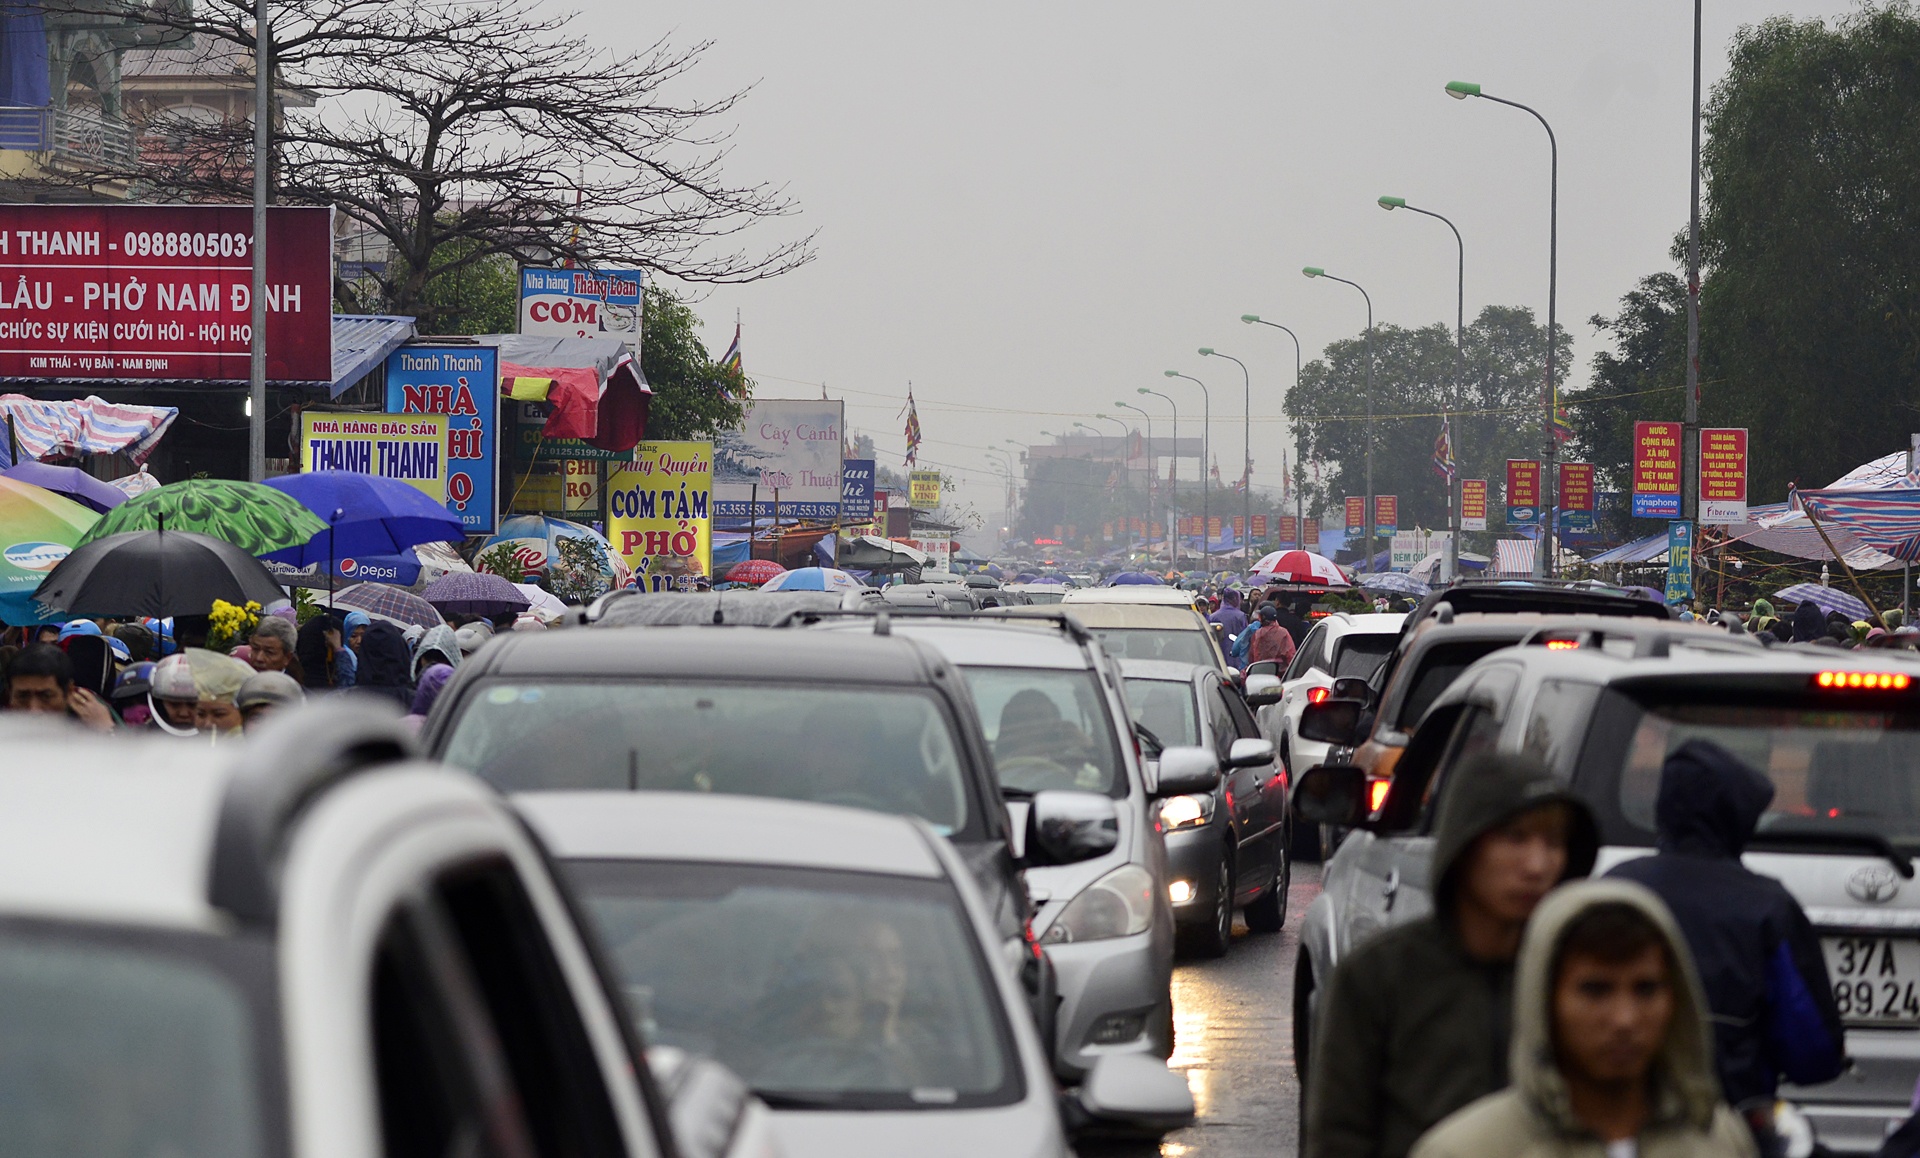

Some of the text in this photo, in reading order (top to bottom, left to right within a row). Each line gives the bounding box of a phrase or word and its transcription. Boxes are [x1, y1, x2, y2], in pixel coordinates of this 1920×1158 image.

[17, 231, 100, 256] THANH
[0, 275, 52, 310] LẨU
[84, 276, 147, 310] PHỞ
[157, 283, 220, 312] NAM
[230, 284, 301, 312] ĐNH
[525, 273, 546, 289] Nhà
[546, 274, 569, 293] hàng
[609, 274, 637, 296] Loan
[530, 298, 597, 324] CƠM
[0, 318, 252, 345] CHỨC SỰ KIỆN CƯỚI HỎI HỘI HỌ
[30, 355, 168, 372] KIM THÁI VỤ BẢN NAM ĐỊNH
[401, 354, 482, 372] Thanh Thanh
[402, 377, 478, 416] NHÀ
[313, 420, 437, 436] NHÀ HÀNG ĐẶC SẢN
[448, 418, 483, 459] HỈ
[760, 423, 838, 449] Cây Cảnh
[1649, 426, 1668, 434] NƯỚC
[1641, 437, 1660, 447] CỘNG
[1647, 448, 1669, 459] XÃ HỘI
[309, 439, 439, 479] THANH THANH
[659, 453, 709, 477] Quyền
[1640, 458, 1676, 469] CHỦ NGHĨA
[761, 467, 840, 494] Nghệ Thuật
[1637, 481, 1658, 490] MUÔN
[1642, 470, 1674, 481] VIỆT NAM
[611, 482, 709, 519] CƠM TÁM
[842, 481, 865, 497] hè
[713, 503, 746, 516] 15.355
[776, 503, 816, 517] 987.553
[819, 504, 837, 517] 858
[1636, 498, 1678, 507] vinaphone
[620, 520, 698, 556] PHỞ
[1394, 550, 1427, 562] RÈM CỬ
[360, 563, 397, 578] pepsi
[635, 557, 674, 592] ẨU
[1838, 940, 1896, 976] 37A
[1835, 980, 1920, 1014] 89.24
